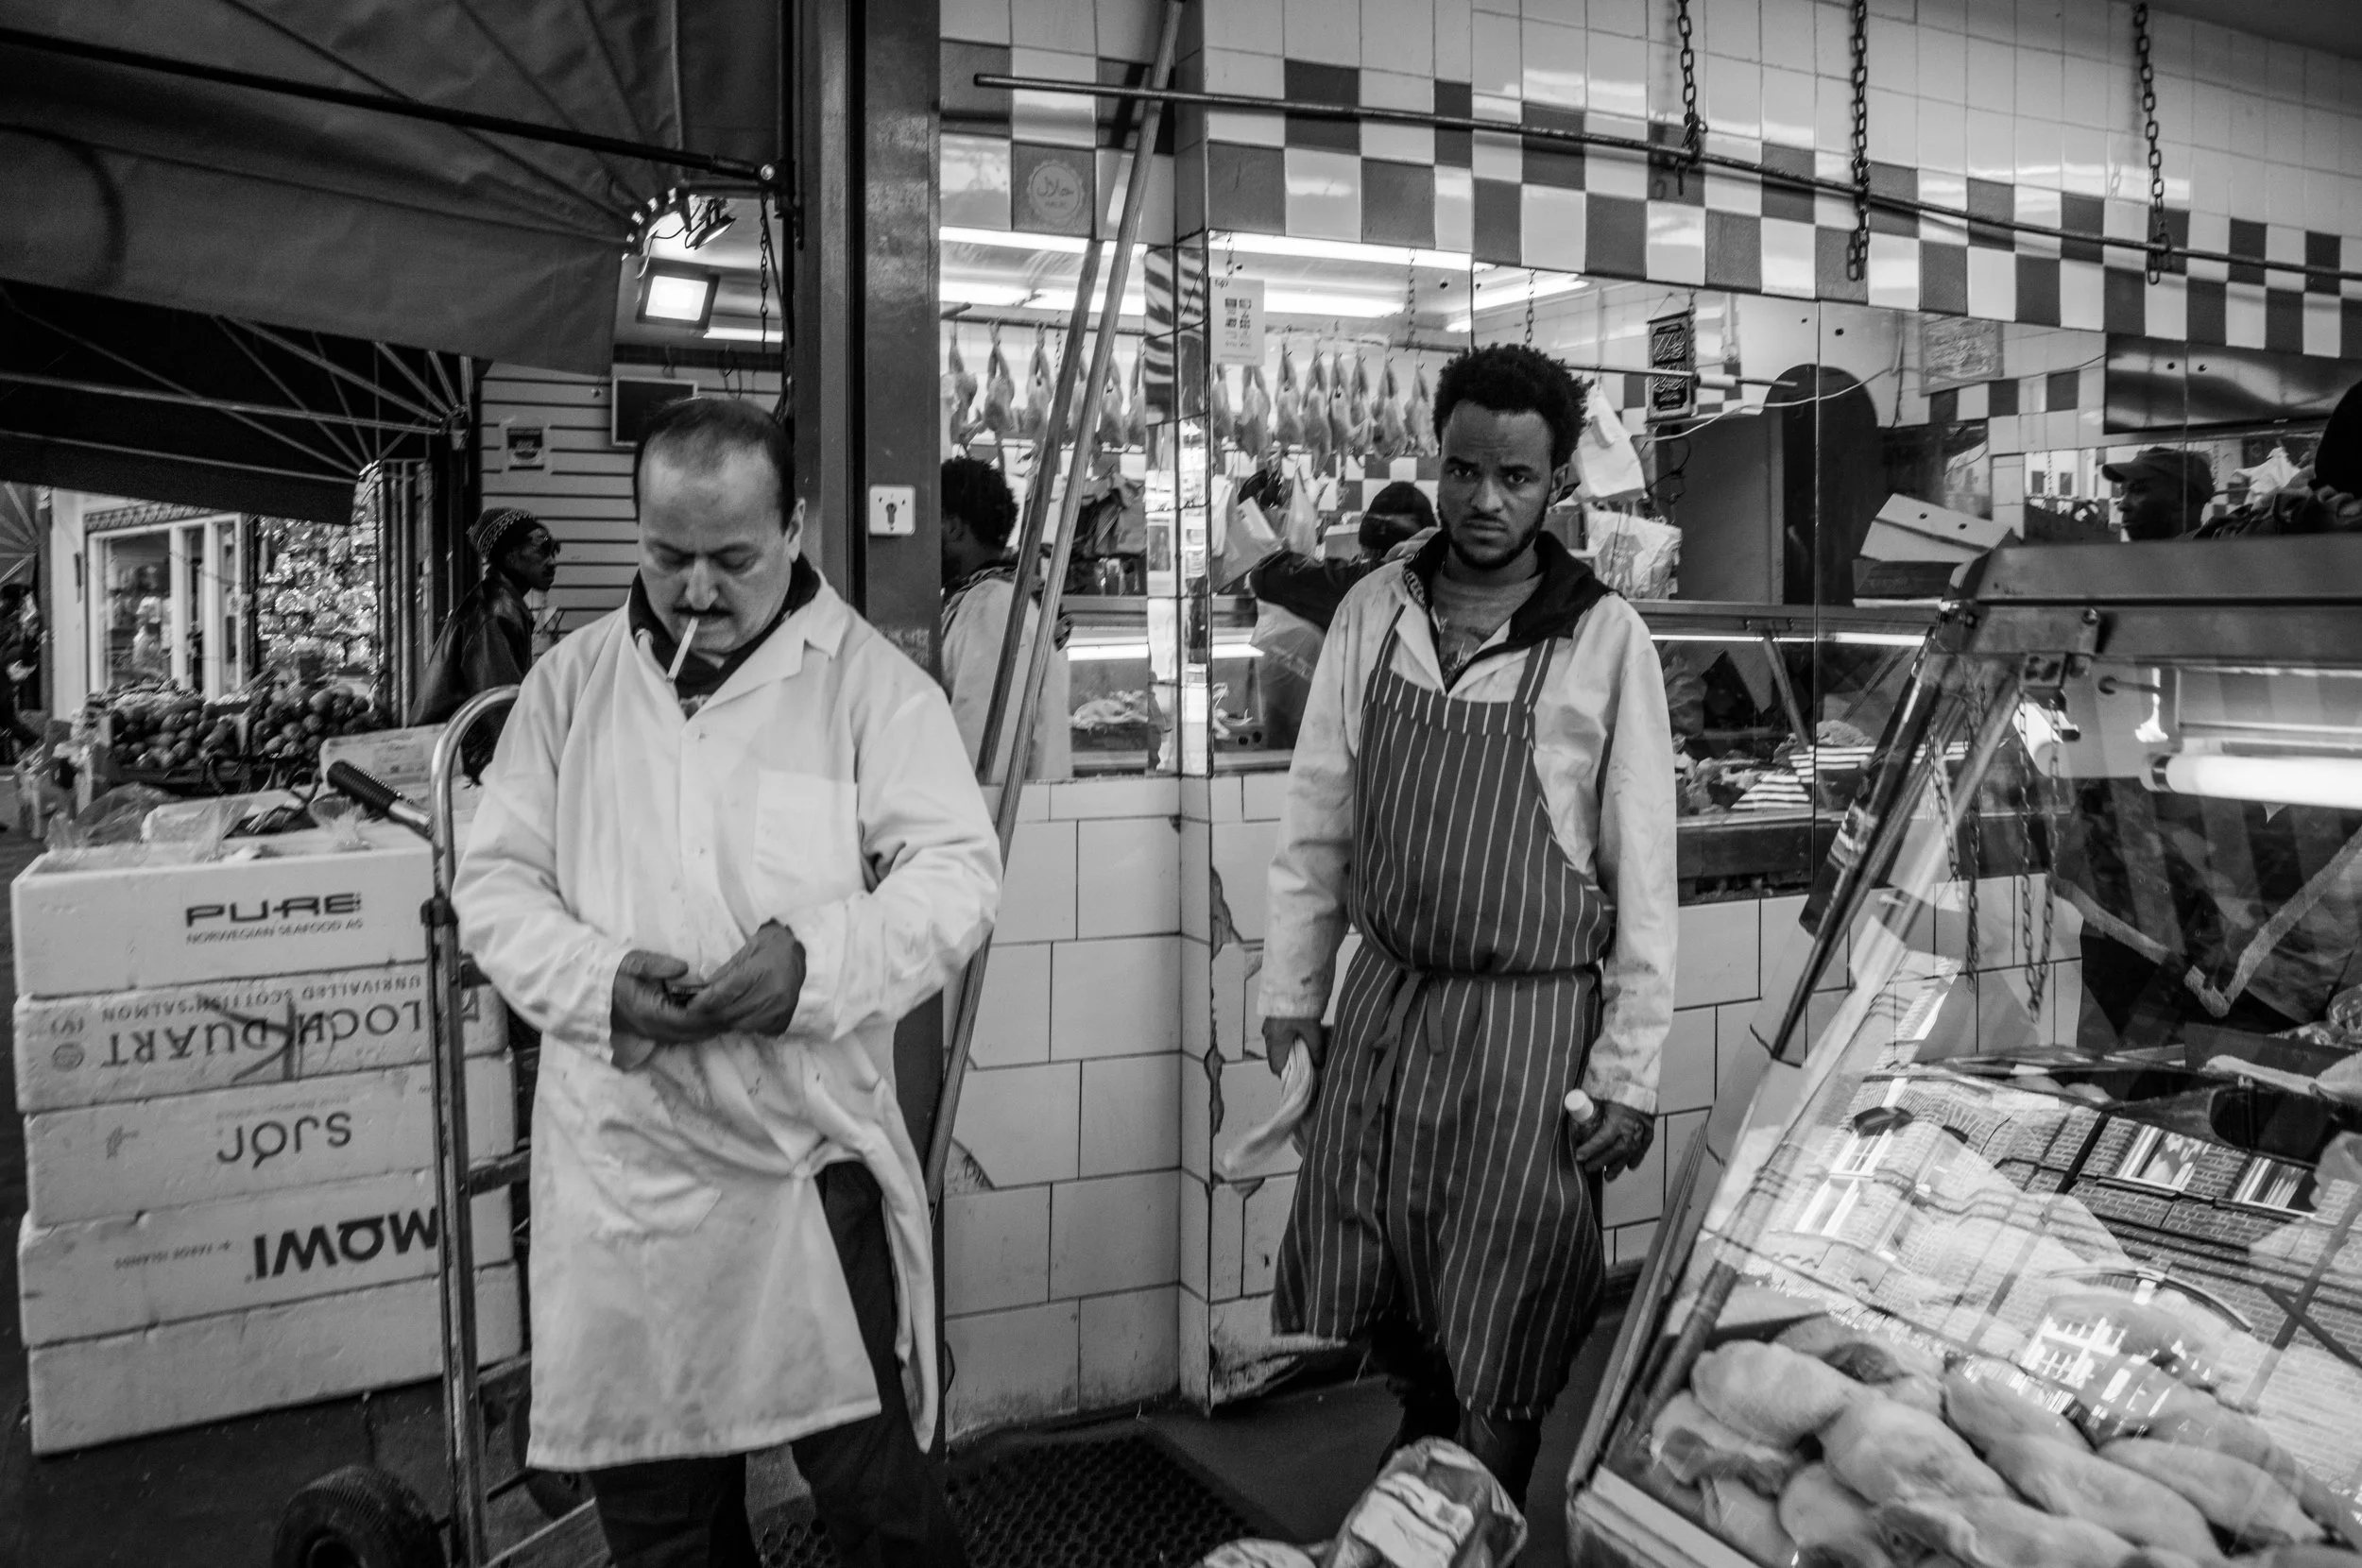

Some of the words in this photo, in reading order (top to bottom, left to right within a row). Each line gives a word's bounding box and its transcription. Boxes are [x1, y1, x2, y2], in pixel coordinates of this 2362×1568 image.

[186, 893, 361, 929] PURE
[101, 998, 189, 1024] SALMON
[294, 999, 422, 1047] LOCH
[100, 1018, 269, 1068] DUART
[253, 1206, 437, 1281] MOWI
